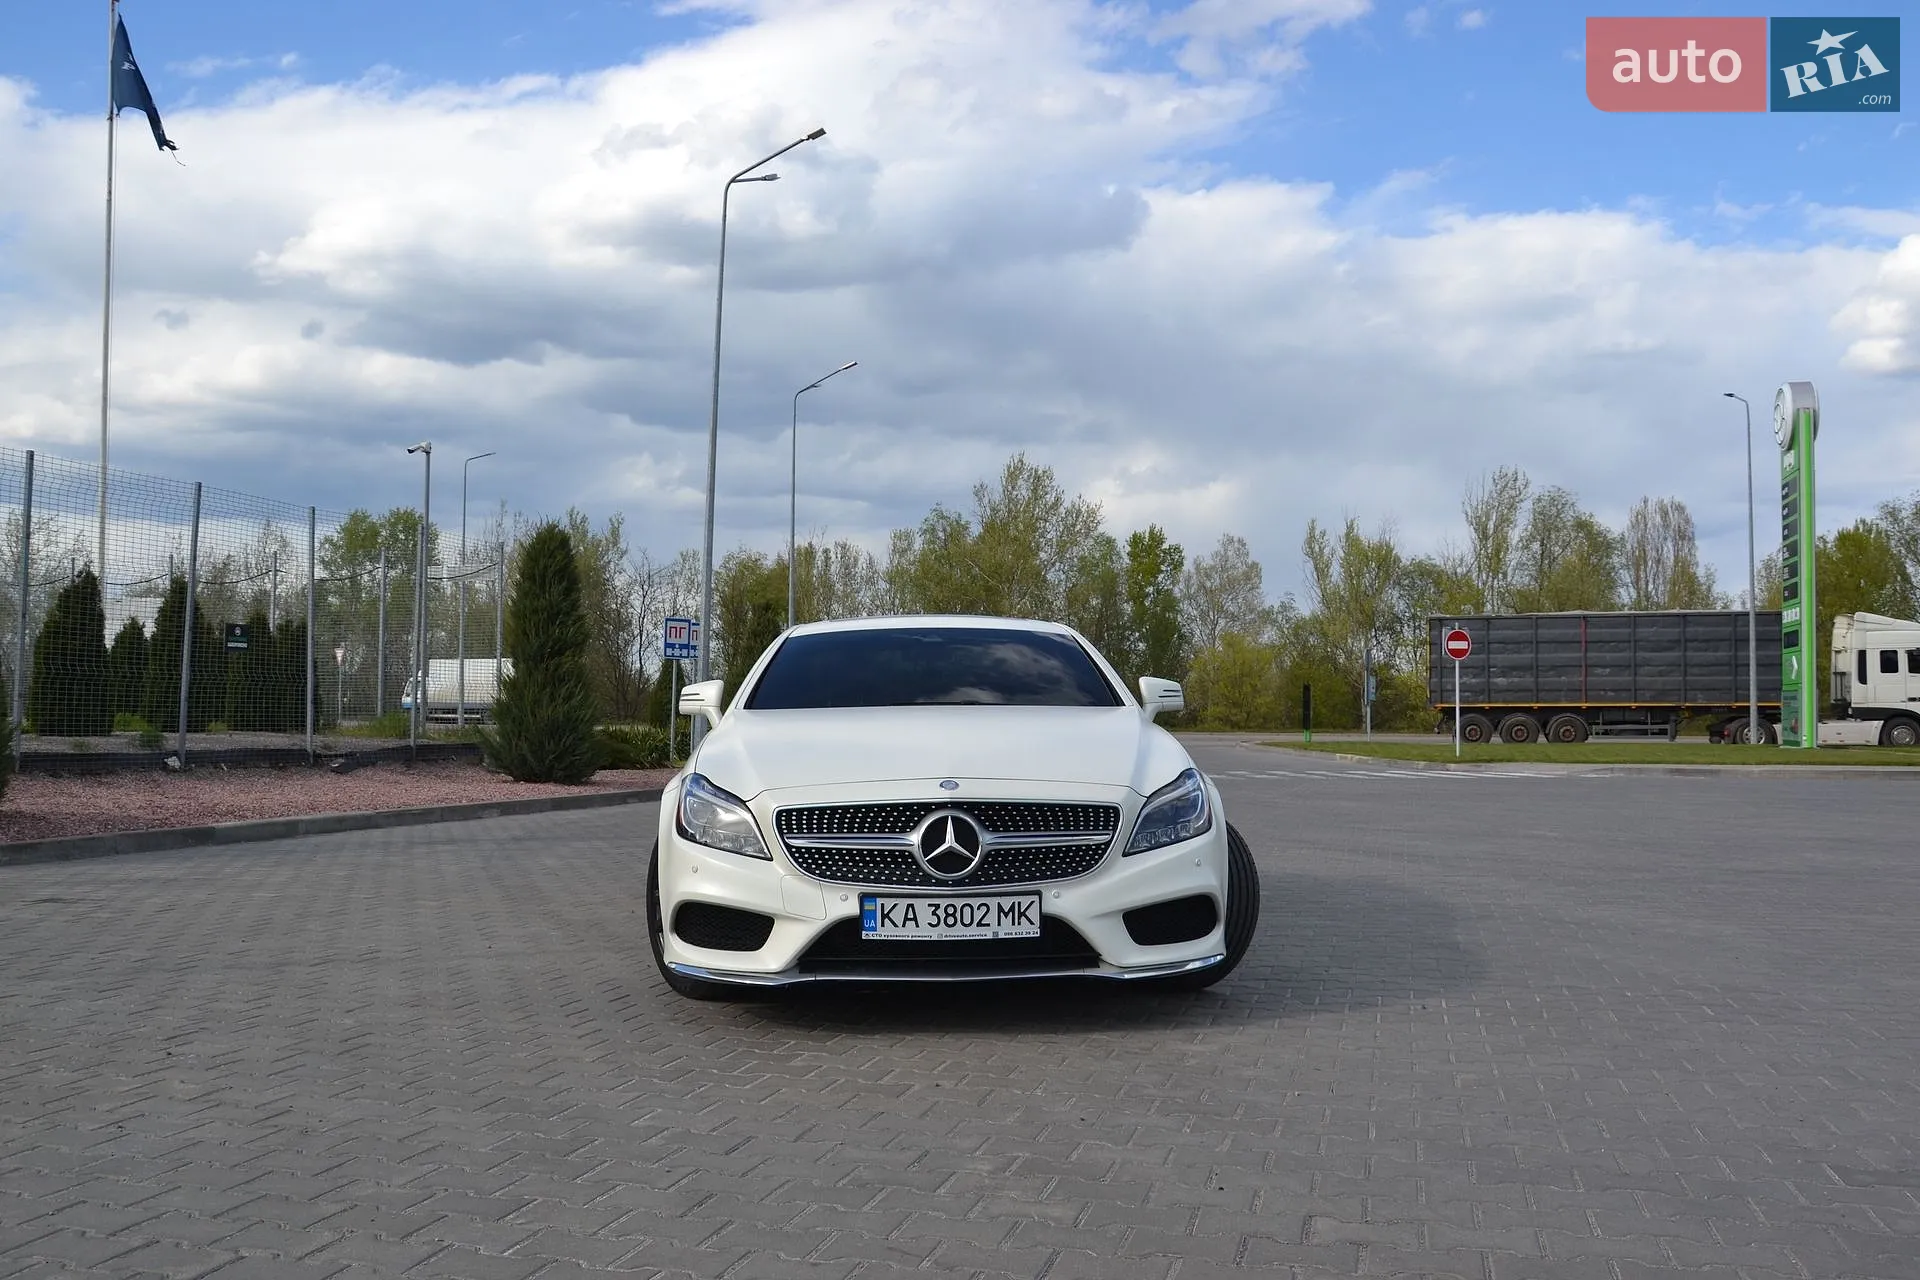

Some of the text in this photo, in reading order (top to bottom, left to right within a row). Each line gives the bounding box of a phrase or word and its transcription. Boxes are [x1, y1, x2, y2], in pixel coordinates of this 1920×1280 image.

[669, 626, 686, 639] ПГ
[880, 900, 1036, 928] KA 3802 MK
[864, 919, 876, 928] UA
